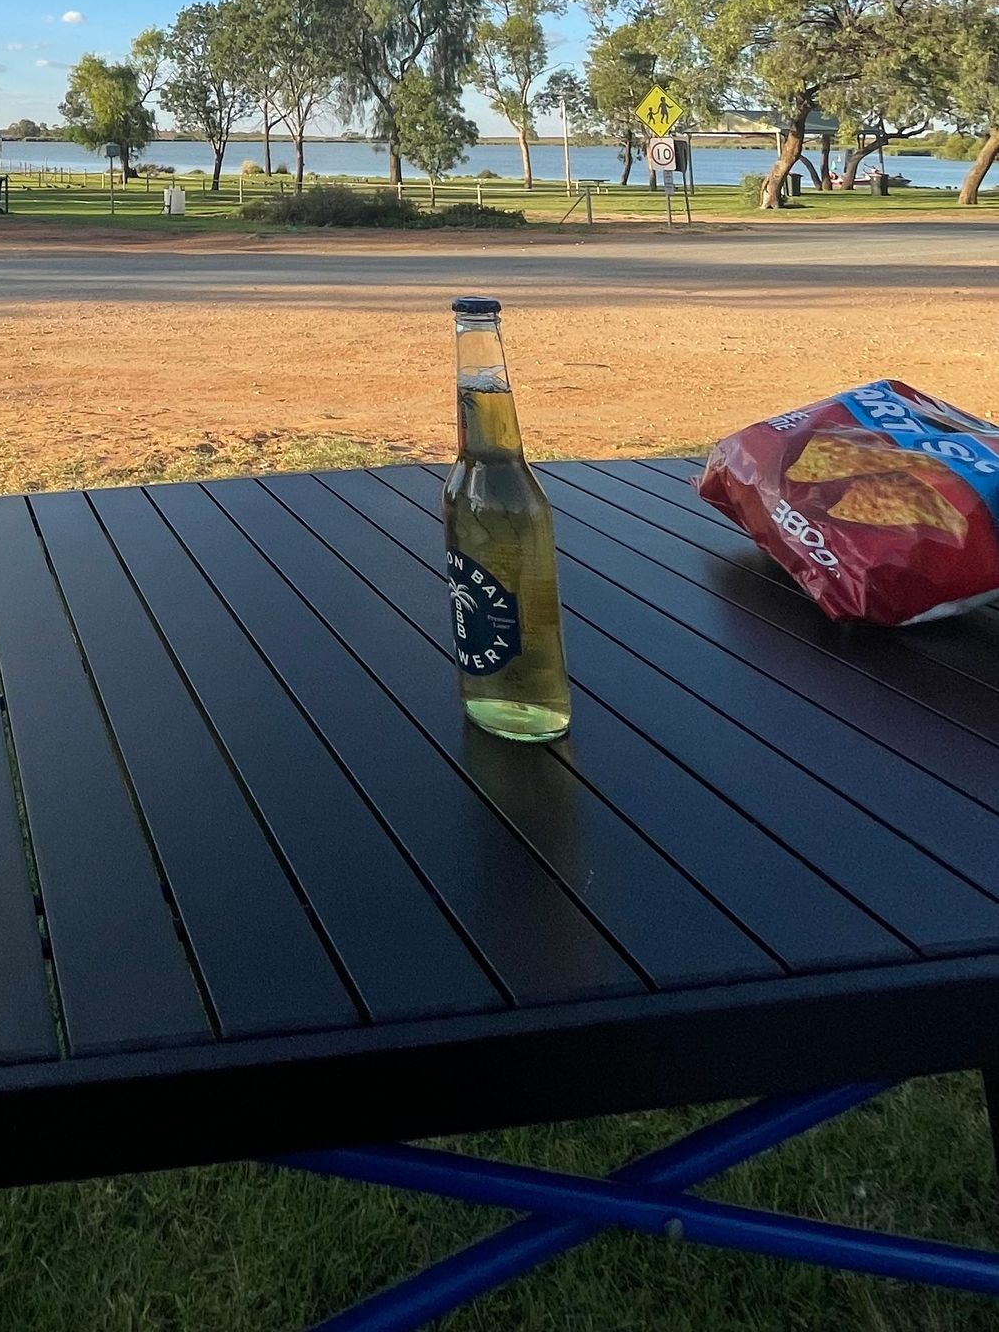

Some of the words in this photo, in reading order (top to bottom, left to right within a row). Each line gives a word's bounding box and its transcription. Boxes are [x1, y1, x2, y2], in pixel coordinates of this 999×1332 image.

[656, 148, 672, 160] 10
[470, 569, 508, 609] BAY
[453, 635, 509, 669] WERY
